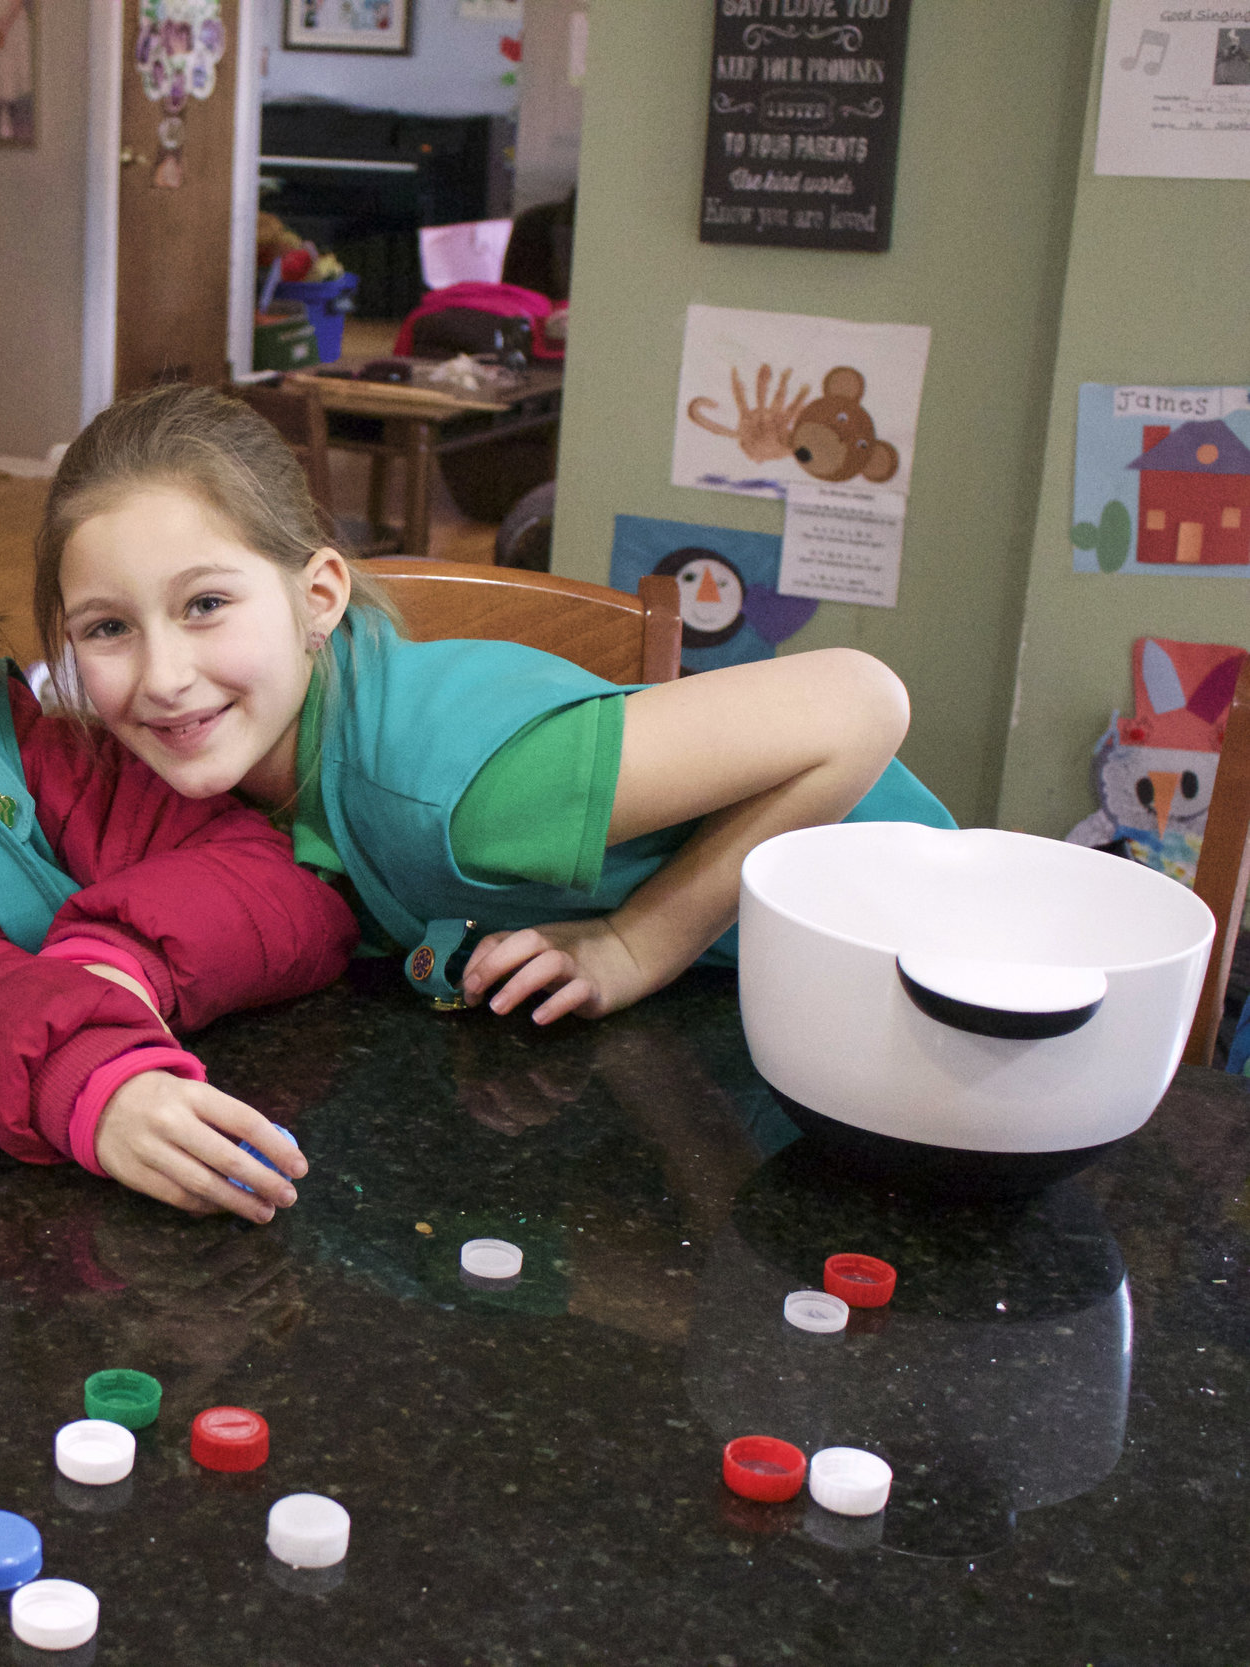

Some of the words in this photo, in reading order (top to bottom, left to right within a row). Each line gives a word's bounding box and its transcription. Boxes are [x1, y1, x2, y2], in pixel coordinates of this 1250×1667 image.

[723, 0, 761, 17] SAY
[770, 0, 778, 17] I
[782, 0, 839, 18] LOVE
[847, 0, 890, 18] YOU
[1160, 9, 1192, 22] Good
[717, 56, 757, 80] KEEP
[762, 57, 803, 81] YOUR
[807, 57, 884, 83] PROMISES
[767, 102, 826, 118] LISTEN
[724, 132, 746, 158] TO
[749, 133, 791, 159] YOUR
[795, 135, 868, 163] PARENTS
[764, 169, 802, 192] kind
[757, 207, 789, 232] you
[794, 210, 824, 229] are
[830, 204, 877, 232] loved
[1116, 390, 1209, 416] James
